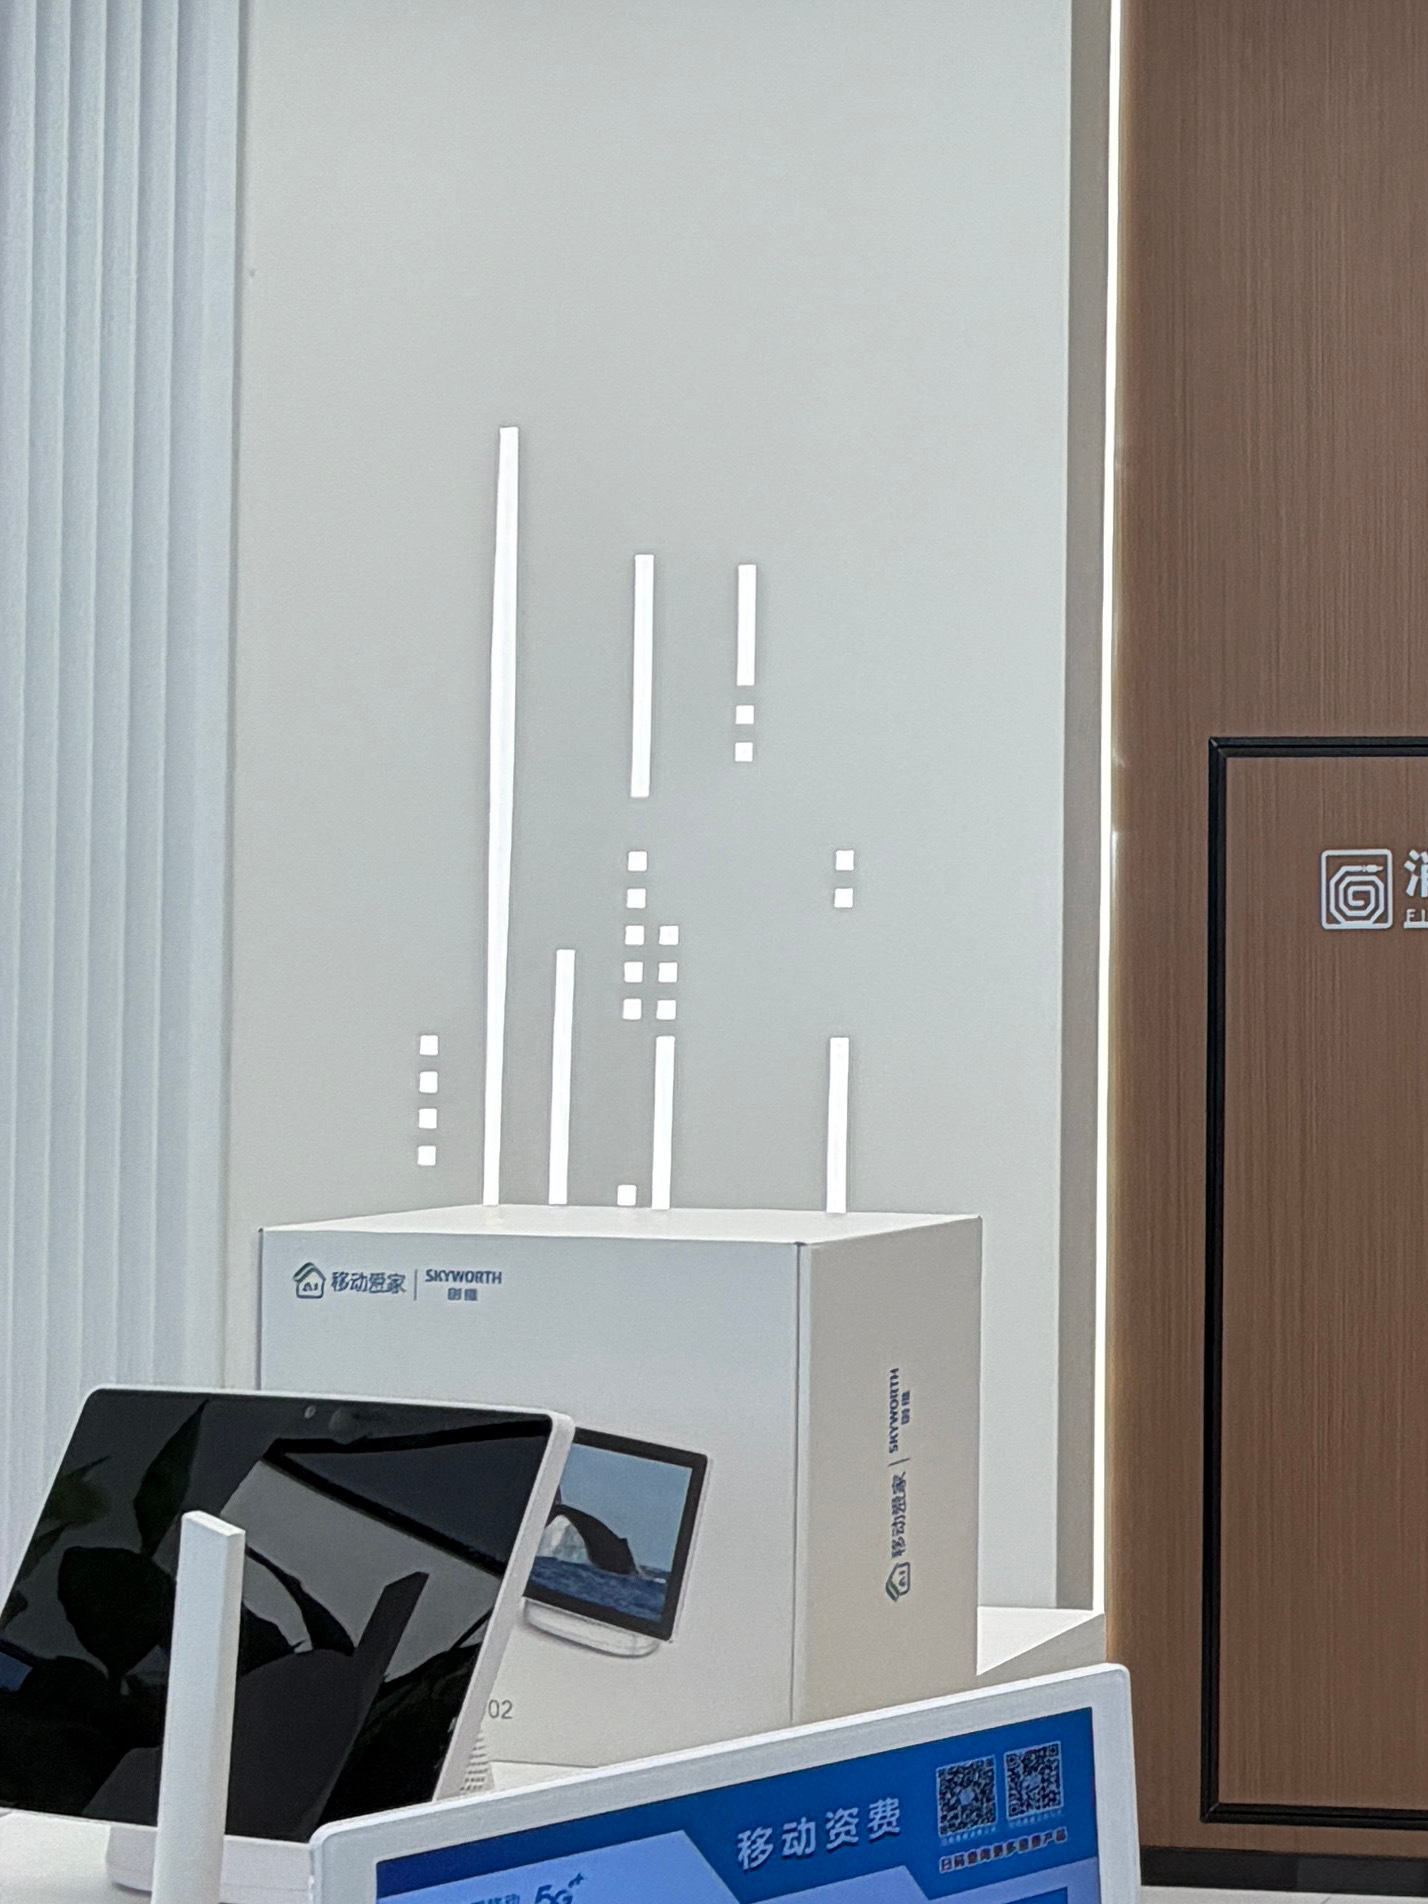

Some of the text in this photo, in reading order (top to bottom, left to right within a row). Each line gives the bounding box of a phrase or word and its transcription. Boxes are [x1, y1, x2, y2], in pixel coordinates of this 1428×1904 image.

[331, 1272, 407, 1294] 移动爱家
[425, 1269, 502, 1284] SKYWORTH
[889, 1368, 899, 1454] SKYWORTH
[737, 1797, 901, 1871] 移动资费
